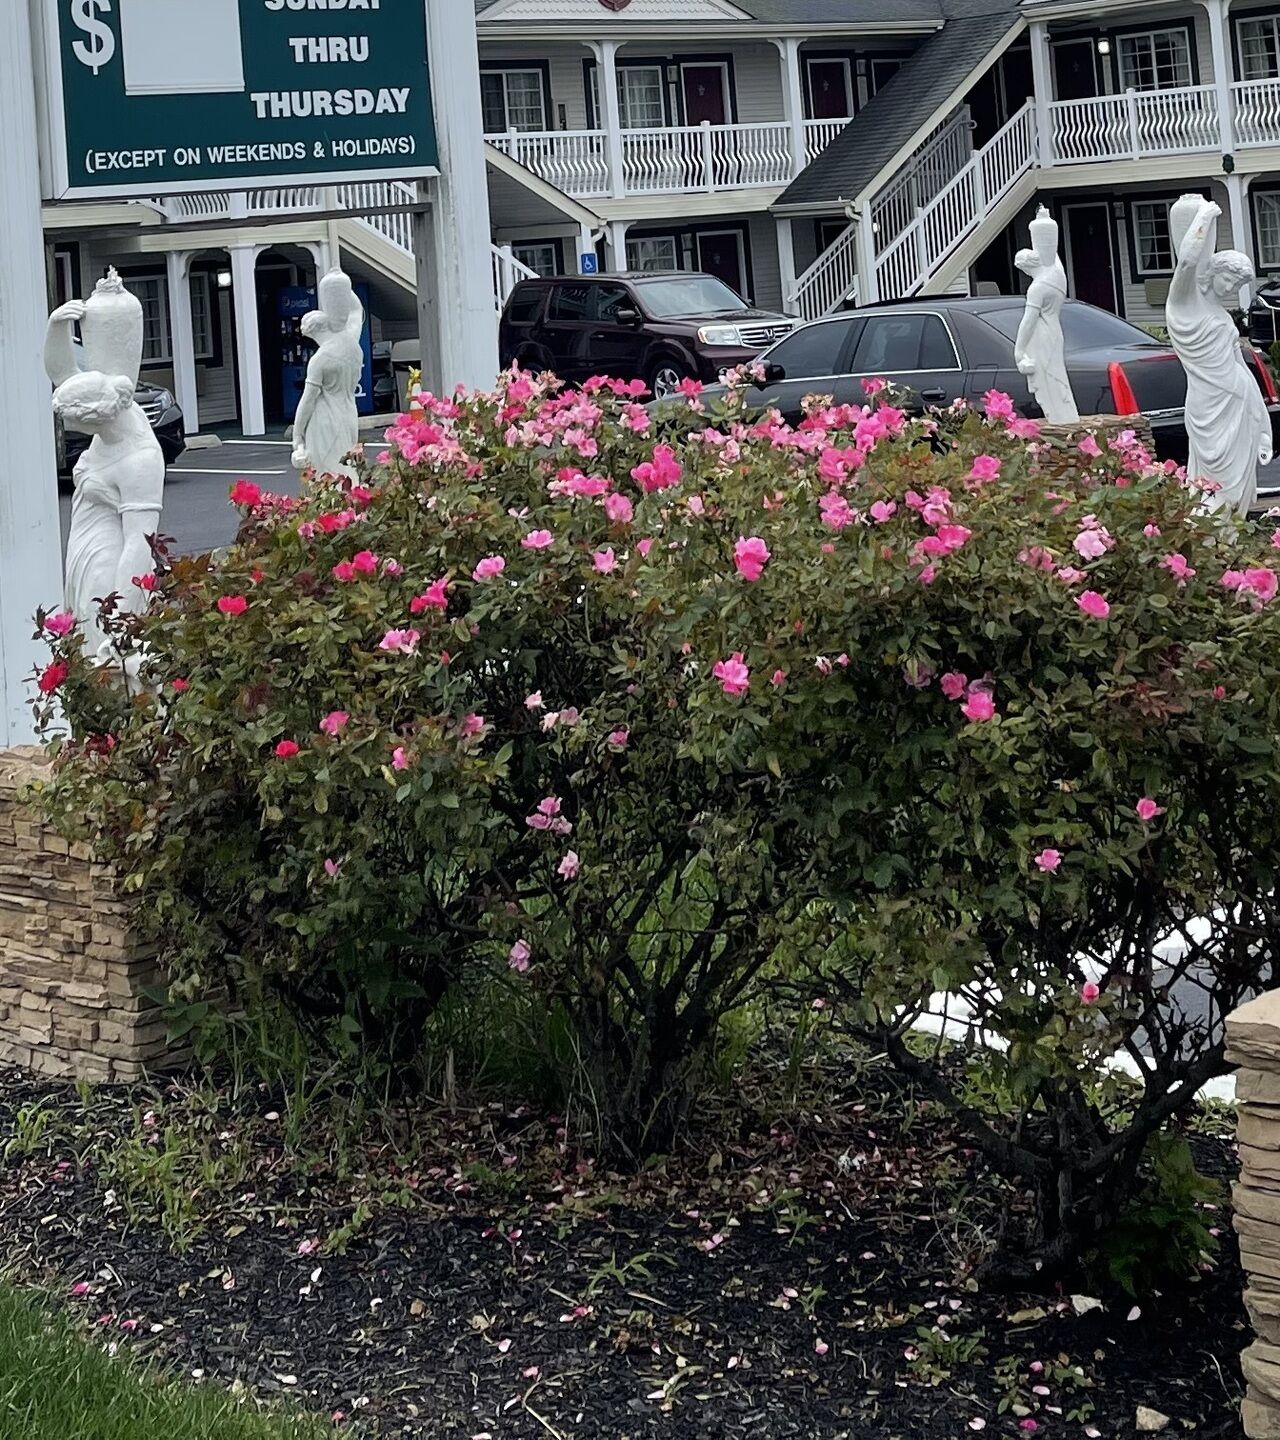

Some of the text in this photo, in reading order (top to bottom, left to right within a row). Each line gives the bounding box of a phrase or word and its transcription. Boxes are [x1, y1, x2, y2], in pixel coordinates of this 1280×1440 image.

[289, 37, 368, 62] THRU
[251, 88, 410, 118] THURSDAY
[86, 135, 416, 173] (EXCEPT ON WEEKENDS & HOLIDAYS)
